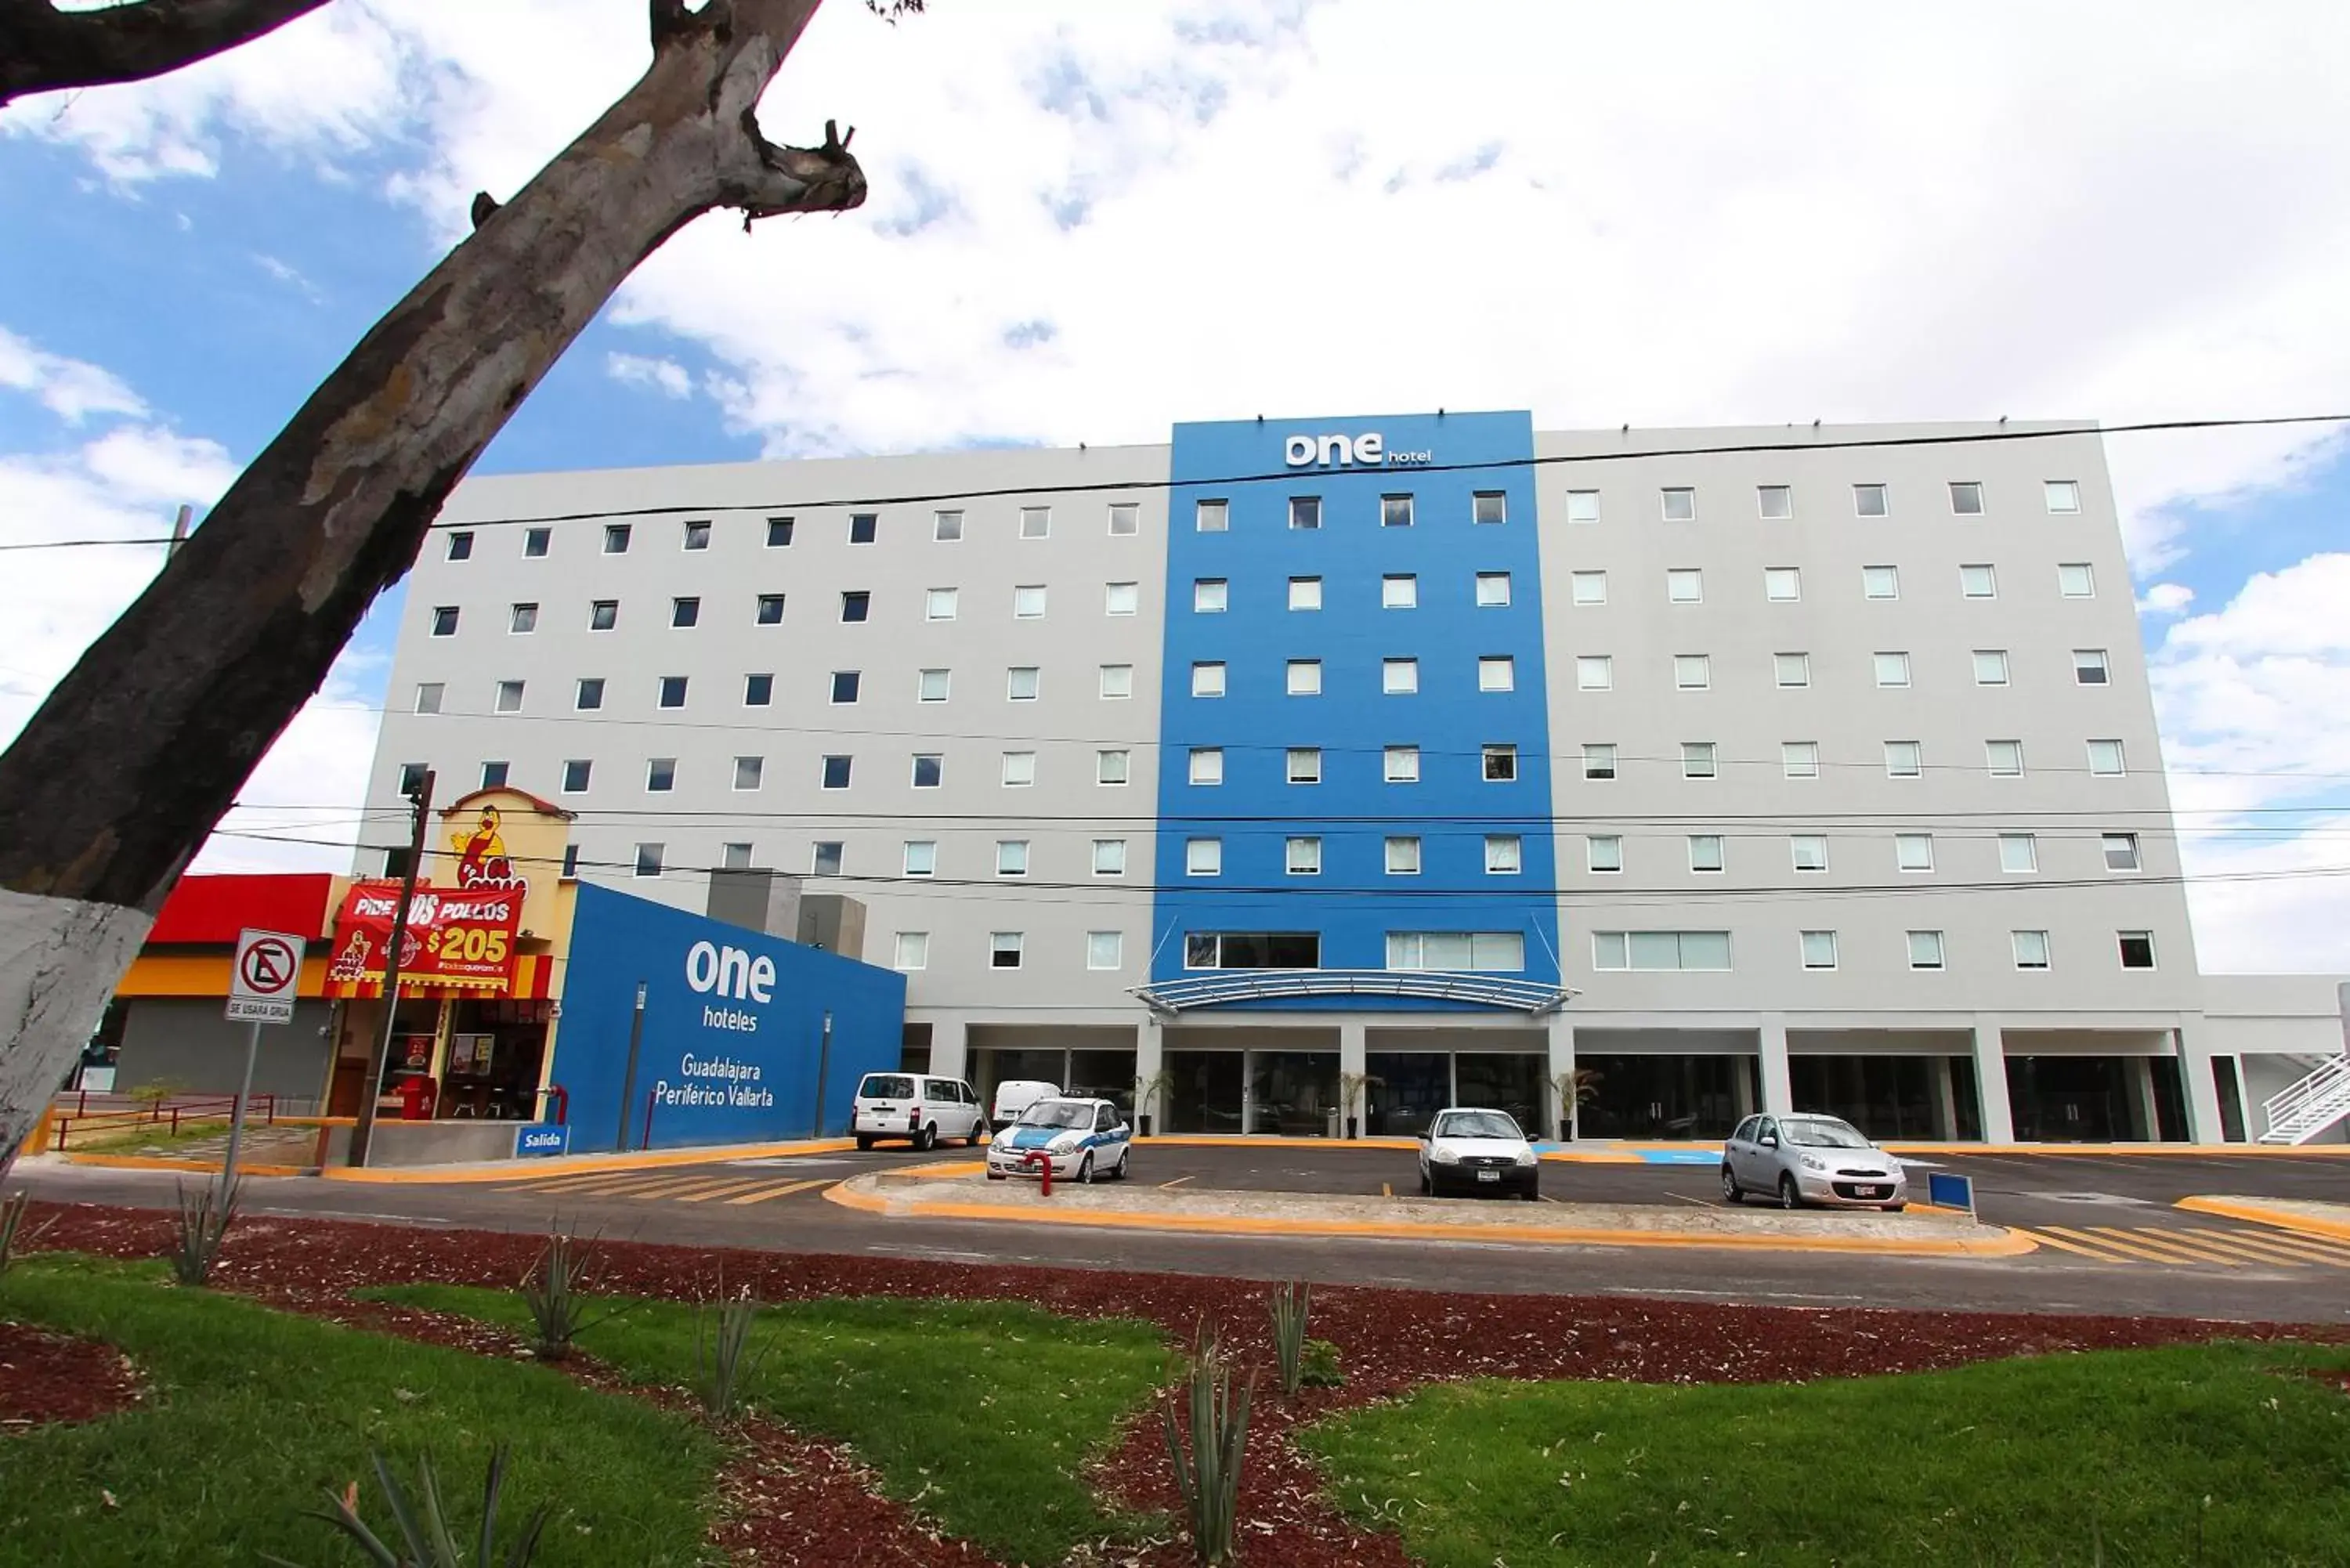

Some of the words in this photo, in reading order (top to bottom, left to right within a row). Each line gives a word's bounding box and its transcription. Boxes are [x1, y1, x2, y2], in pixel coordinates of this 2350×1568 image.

[1285, 432, 1383, 466] one
[1389, 450, 1432, 463] hotel
[354, 898, 396, 916] PIDE
[439, 902, 510, 921] POLLOS
[427, 927, 509, 962] $205
[686, 940, 776, 1003] one
[230, 1003, 241, 1014] SE
[703, 1006, 758, 1031] hoteles
[682, 1053, 761, 1084] Guadalajara
[656, 1081, 725, 1106] Periférico
[728, 1085, 773, 1107] Vallarta
[525, 1133, 561, 1147] Salida
